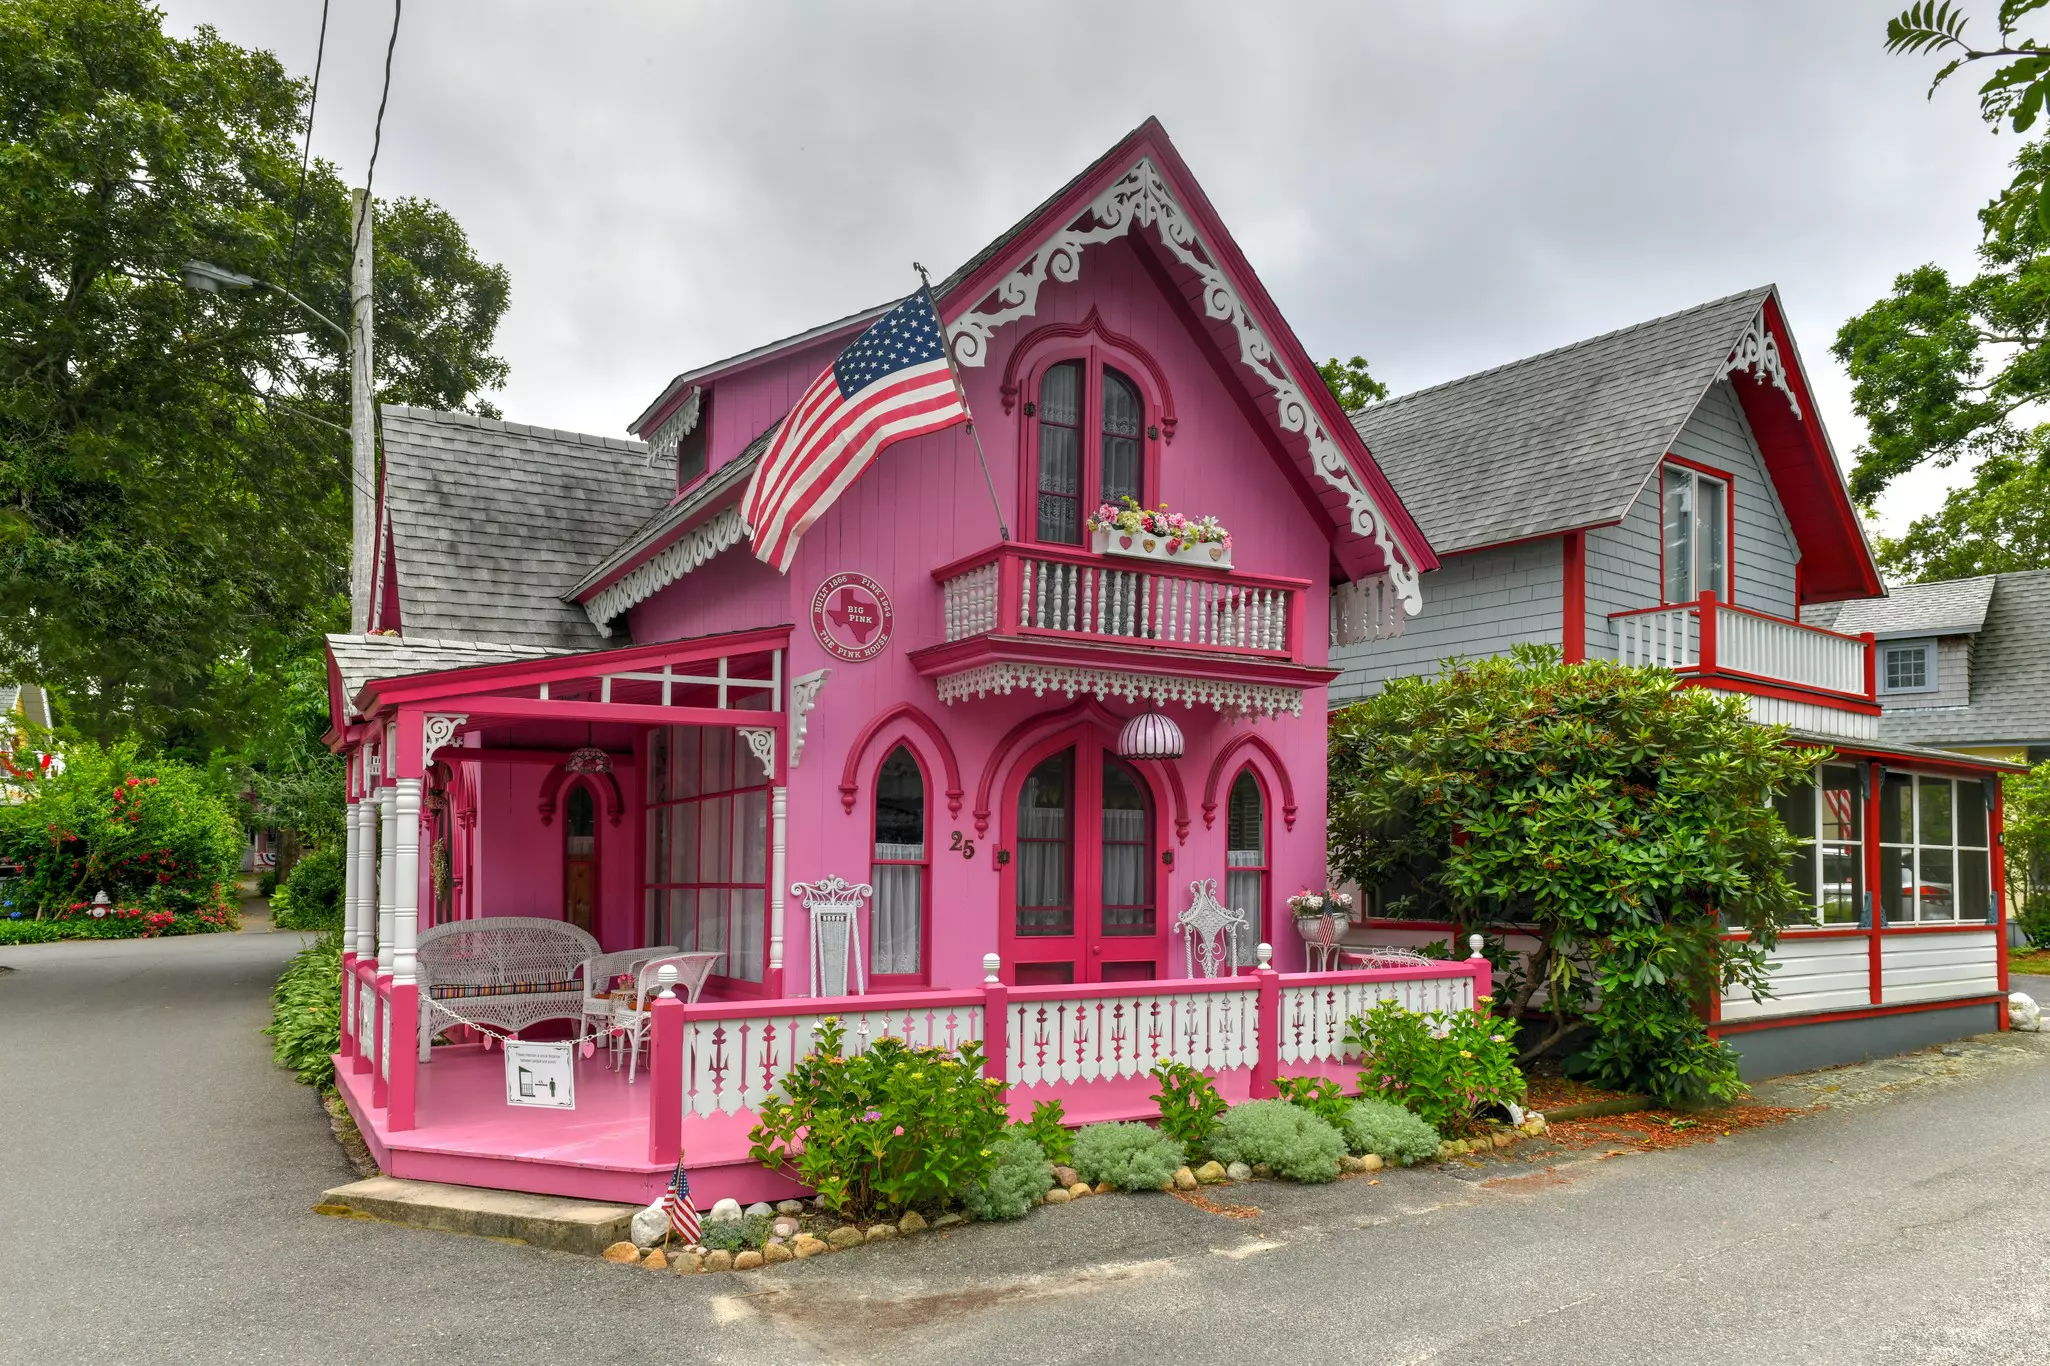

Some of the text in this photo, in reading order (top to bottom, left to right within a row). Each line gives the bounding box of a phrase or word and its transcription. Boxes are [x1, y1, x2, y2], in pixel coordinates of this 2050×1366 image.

[815, 576, 847, 613] BUILT 1866
[861, 578, 891, 617] PINK 1944
[849, 615, 872, 623] PINK
[820, 630, 888, 658] THE PINK HOUSE
[949, 831, 975, 859] 25
